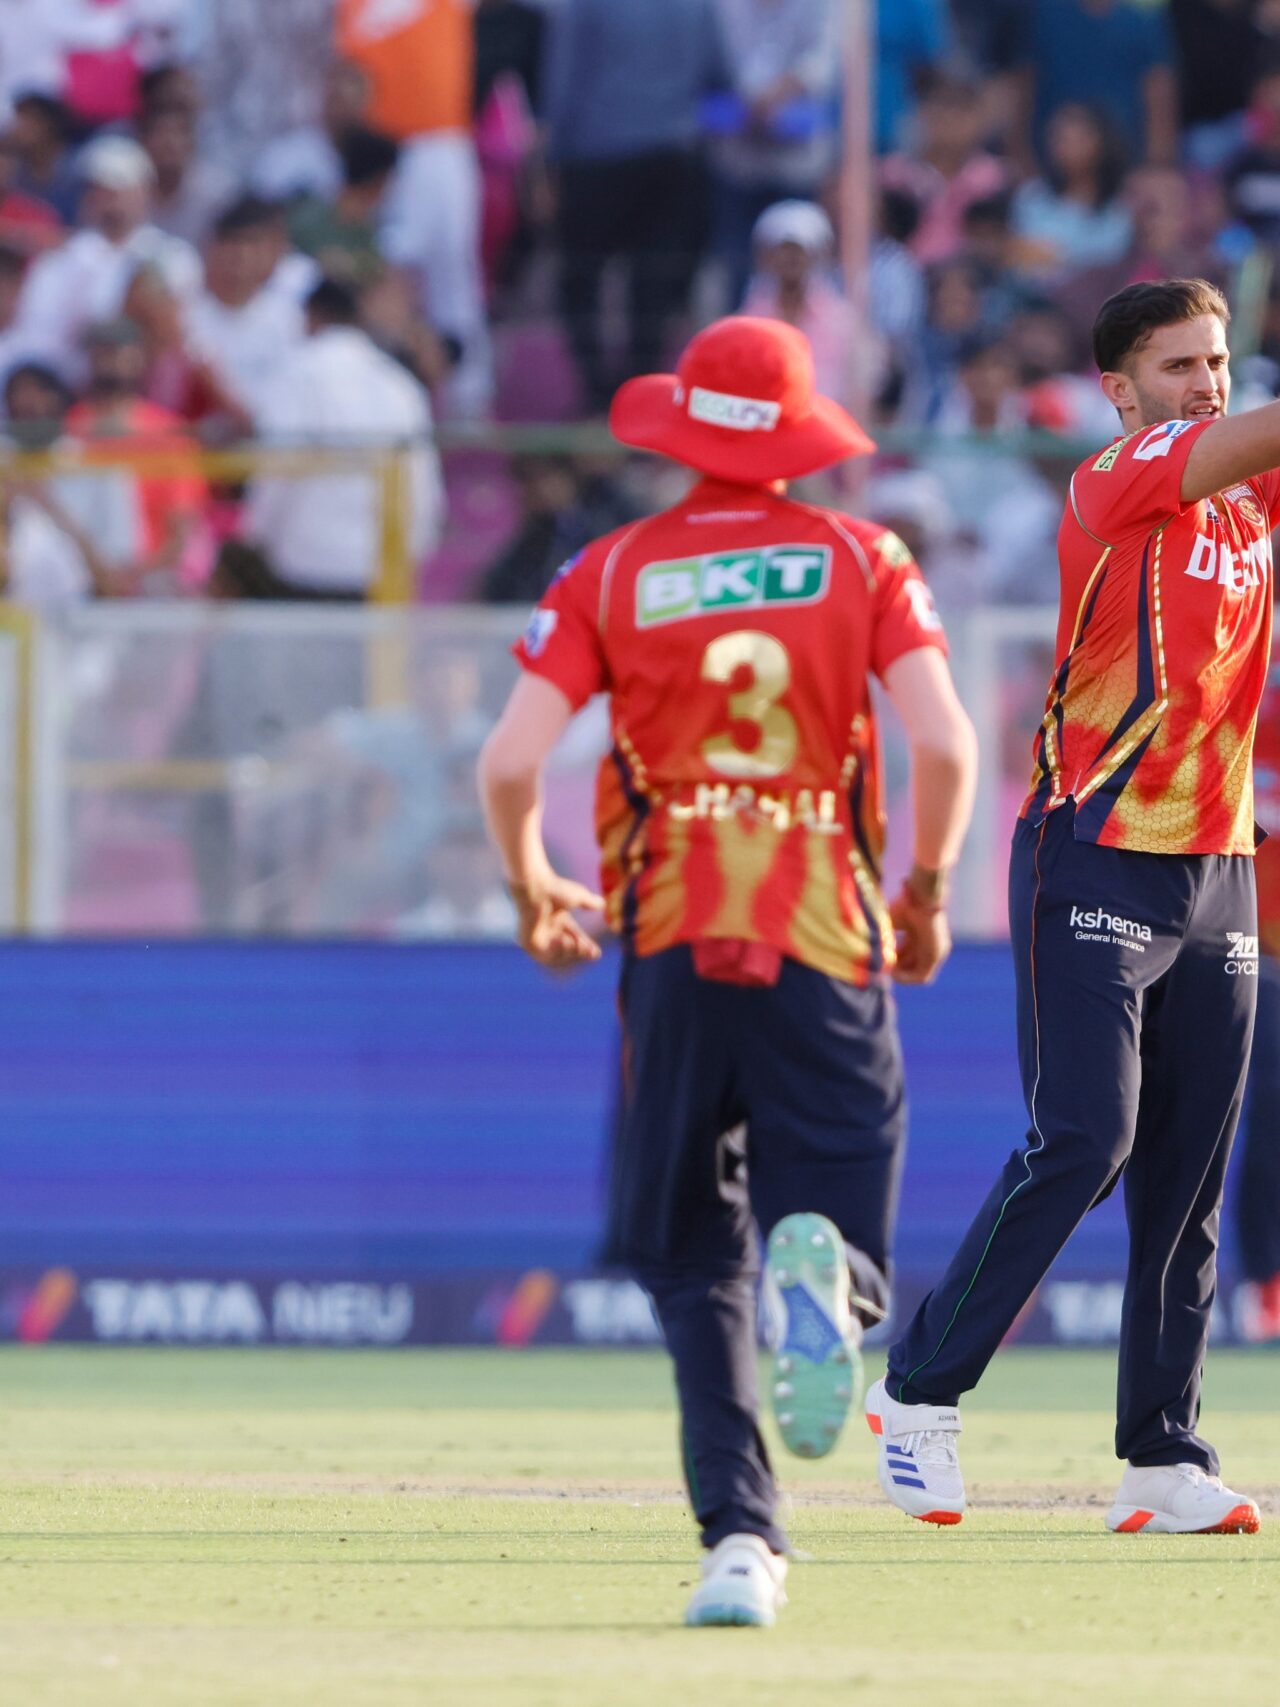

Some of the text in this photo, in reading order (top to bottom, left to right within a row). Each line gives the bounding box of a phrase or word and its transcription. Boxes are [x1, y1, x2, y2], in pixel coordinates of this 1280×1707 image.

[643, 555, 823, 613] BKT
[700, 629, 795, 780] 3
[1069, 905, 1152, 942] kshema
[1075, 930, 1145, 953] General Insurance
[86, 1279, 414, 1342] TATA NEU
